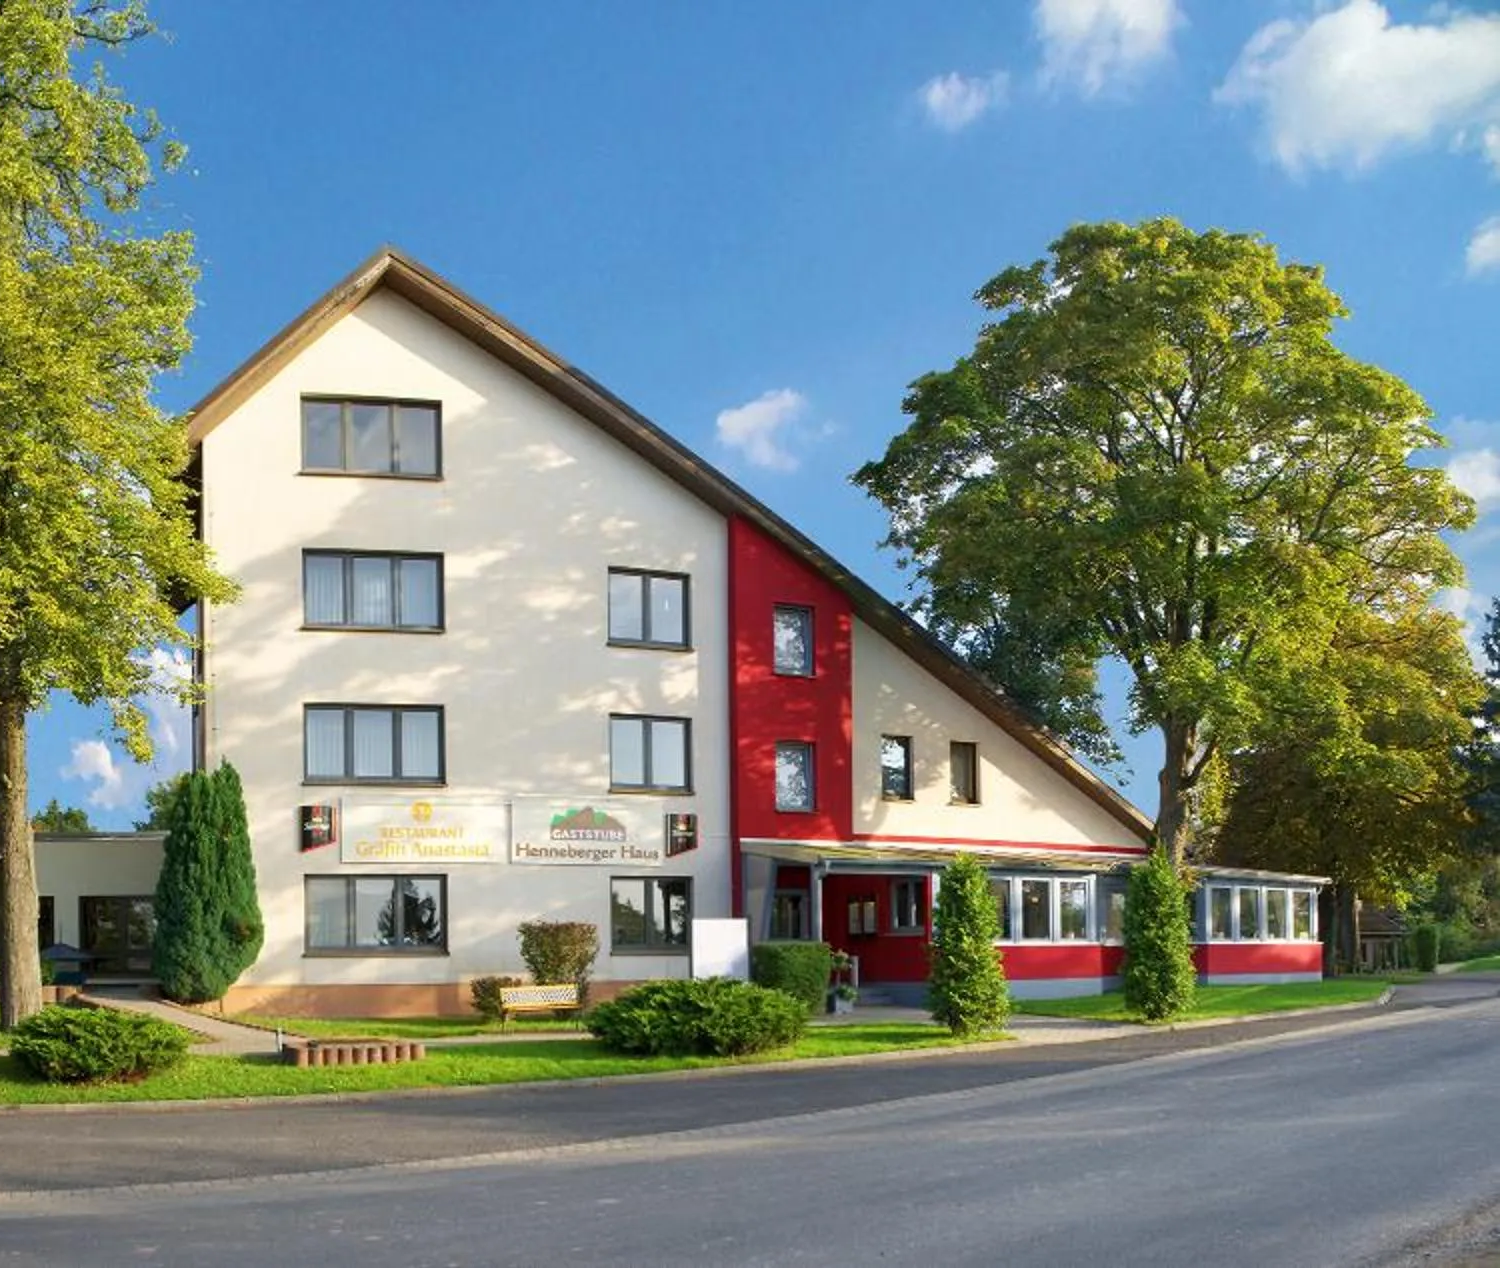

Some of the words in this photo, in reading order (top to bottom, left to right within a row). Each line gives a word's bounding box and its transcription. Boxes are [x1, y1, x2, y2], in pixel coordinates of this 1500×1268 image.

[379, 827, 464, 840] RESTAURANT
[552, 829, 626, 840] GASTSTUBE
[515, 843, 617, 861] Henneberger
[621, 845, 660, 859] Haus
